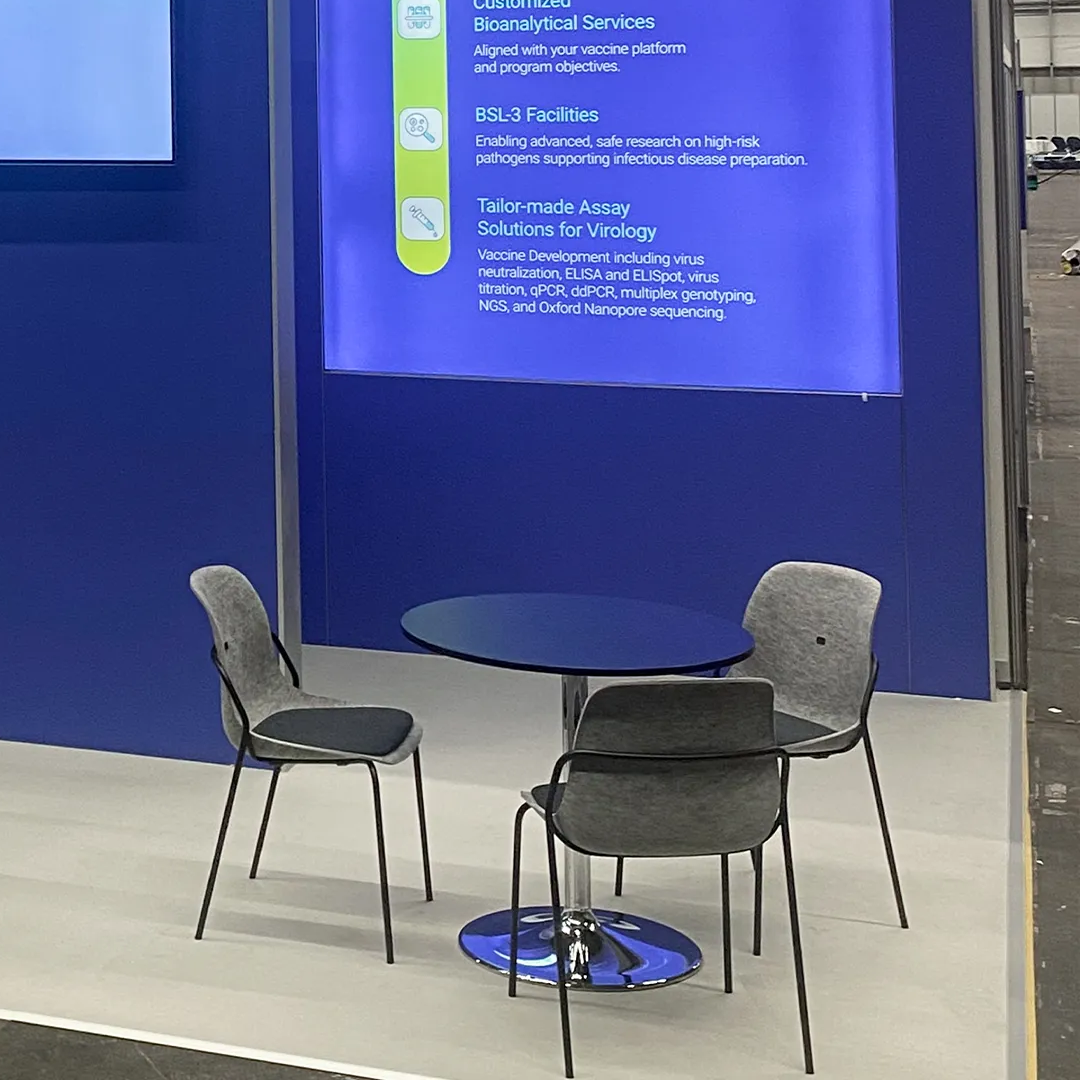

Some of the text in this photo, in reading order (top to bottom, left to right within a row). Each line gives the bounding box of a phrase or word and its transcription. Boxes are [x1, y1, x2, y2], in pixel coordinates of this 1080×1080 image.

[474, 14, 655, 35] Bioanalytical Services
[473, 41, 687, 59] Aligned with your vaccine platform
[474, 60, 621, 76] and program objectives.
[475, 106, 599, 122] BSL-3 Facilities
[475, 134, 760, 151] Enabling advanced, safe research on high-risk
[476, 151, 808, 168] pathogens supporting infectious disease preparation.
[477, 197, 630, 219] Tailor-made Assay
[477, 220, 657, 243] Solutions for Virology
[477, 248, 704, 267] Vaccine Development including virus
[478, 266, 720, 284] neutralization, ELISA and ELISpot, virus
[478, 282, 756, 305] titration, qPCR, ddPCR, multiplex genotyping,
[479, 299, 727, 321] NGS, and Oxford Nanopore sequencing.
